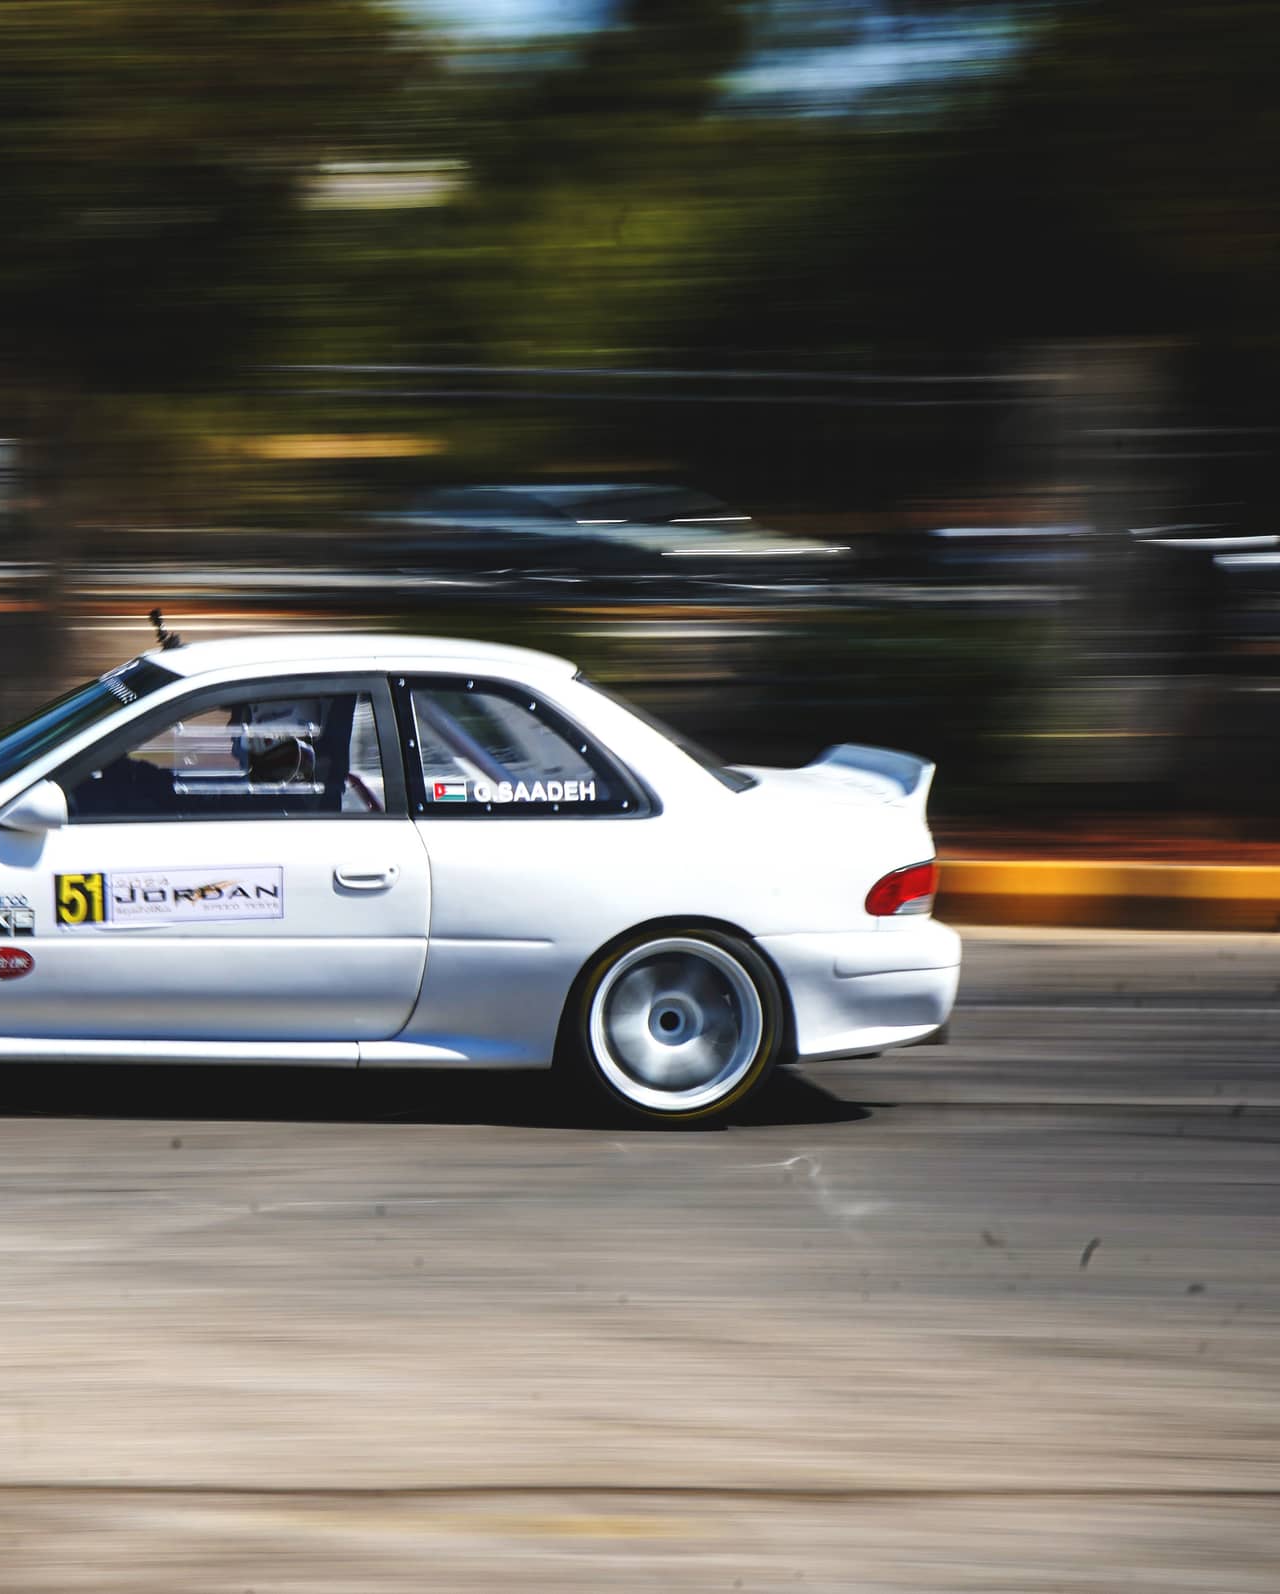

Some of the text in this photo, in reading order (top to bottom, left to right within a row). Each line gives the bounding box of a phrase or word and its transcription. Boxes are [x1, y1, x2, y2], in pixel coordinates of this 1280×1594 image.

[473, 780, 597, 803] G.SAADEH
[60, 873, 103, 924] 51
[115, 883, 279, 904] JORDAN
